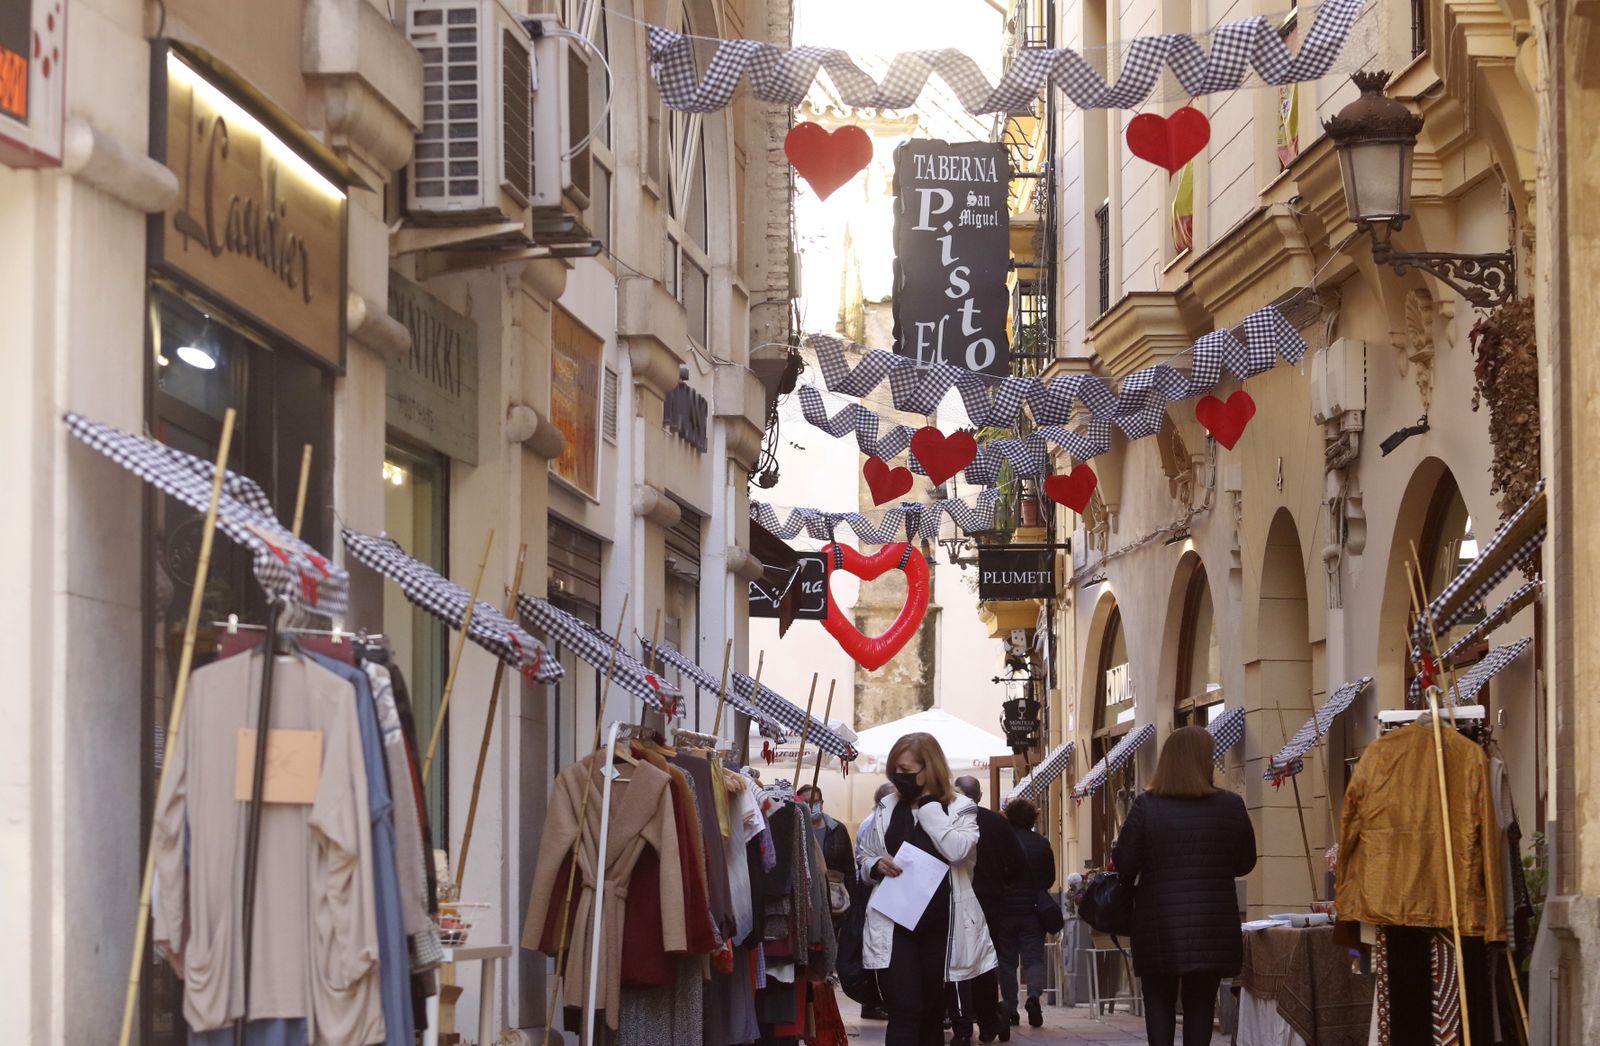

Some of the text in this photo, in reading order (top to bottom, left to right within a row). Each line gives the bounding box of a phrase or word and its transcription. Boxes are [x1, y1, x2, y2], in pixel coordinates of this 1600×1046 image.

[913, 154, 999, 183] TABERNA
[966, 190, 990, 207] San
[958, 209, 999, 228] Miguel
[914, 314, 950, 370] El
[983, 571, 1053, 584] PLUMETI
